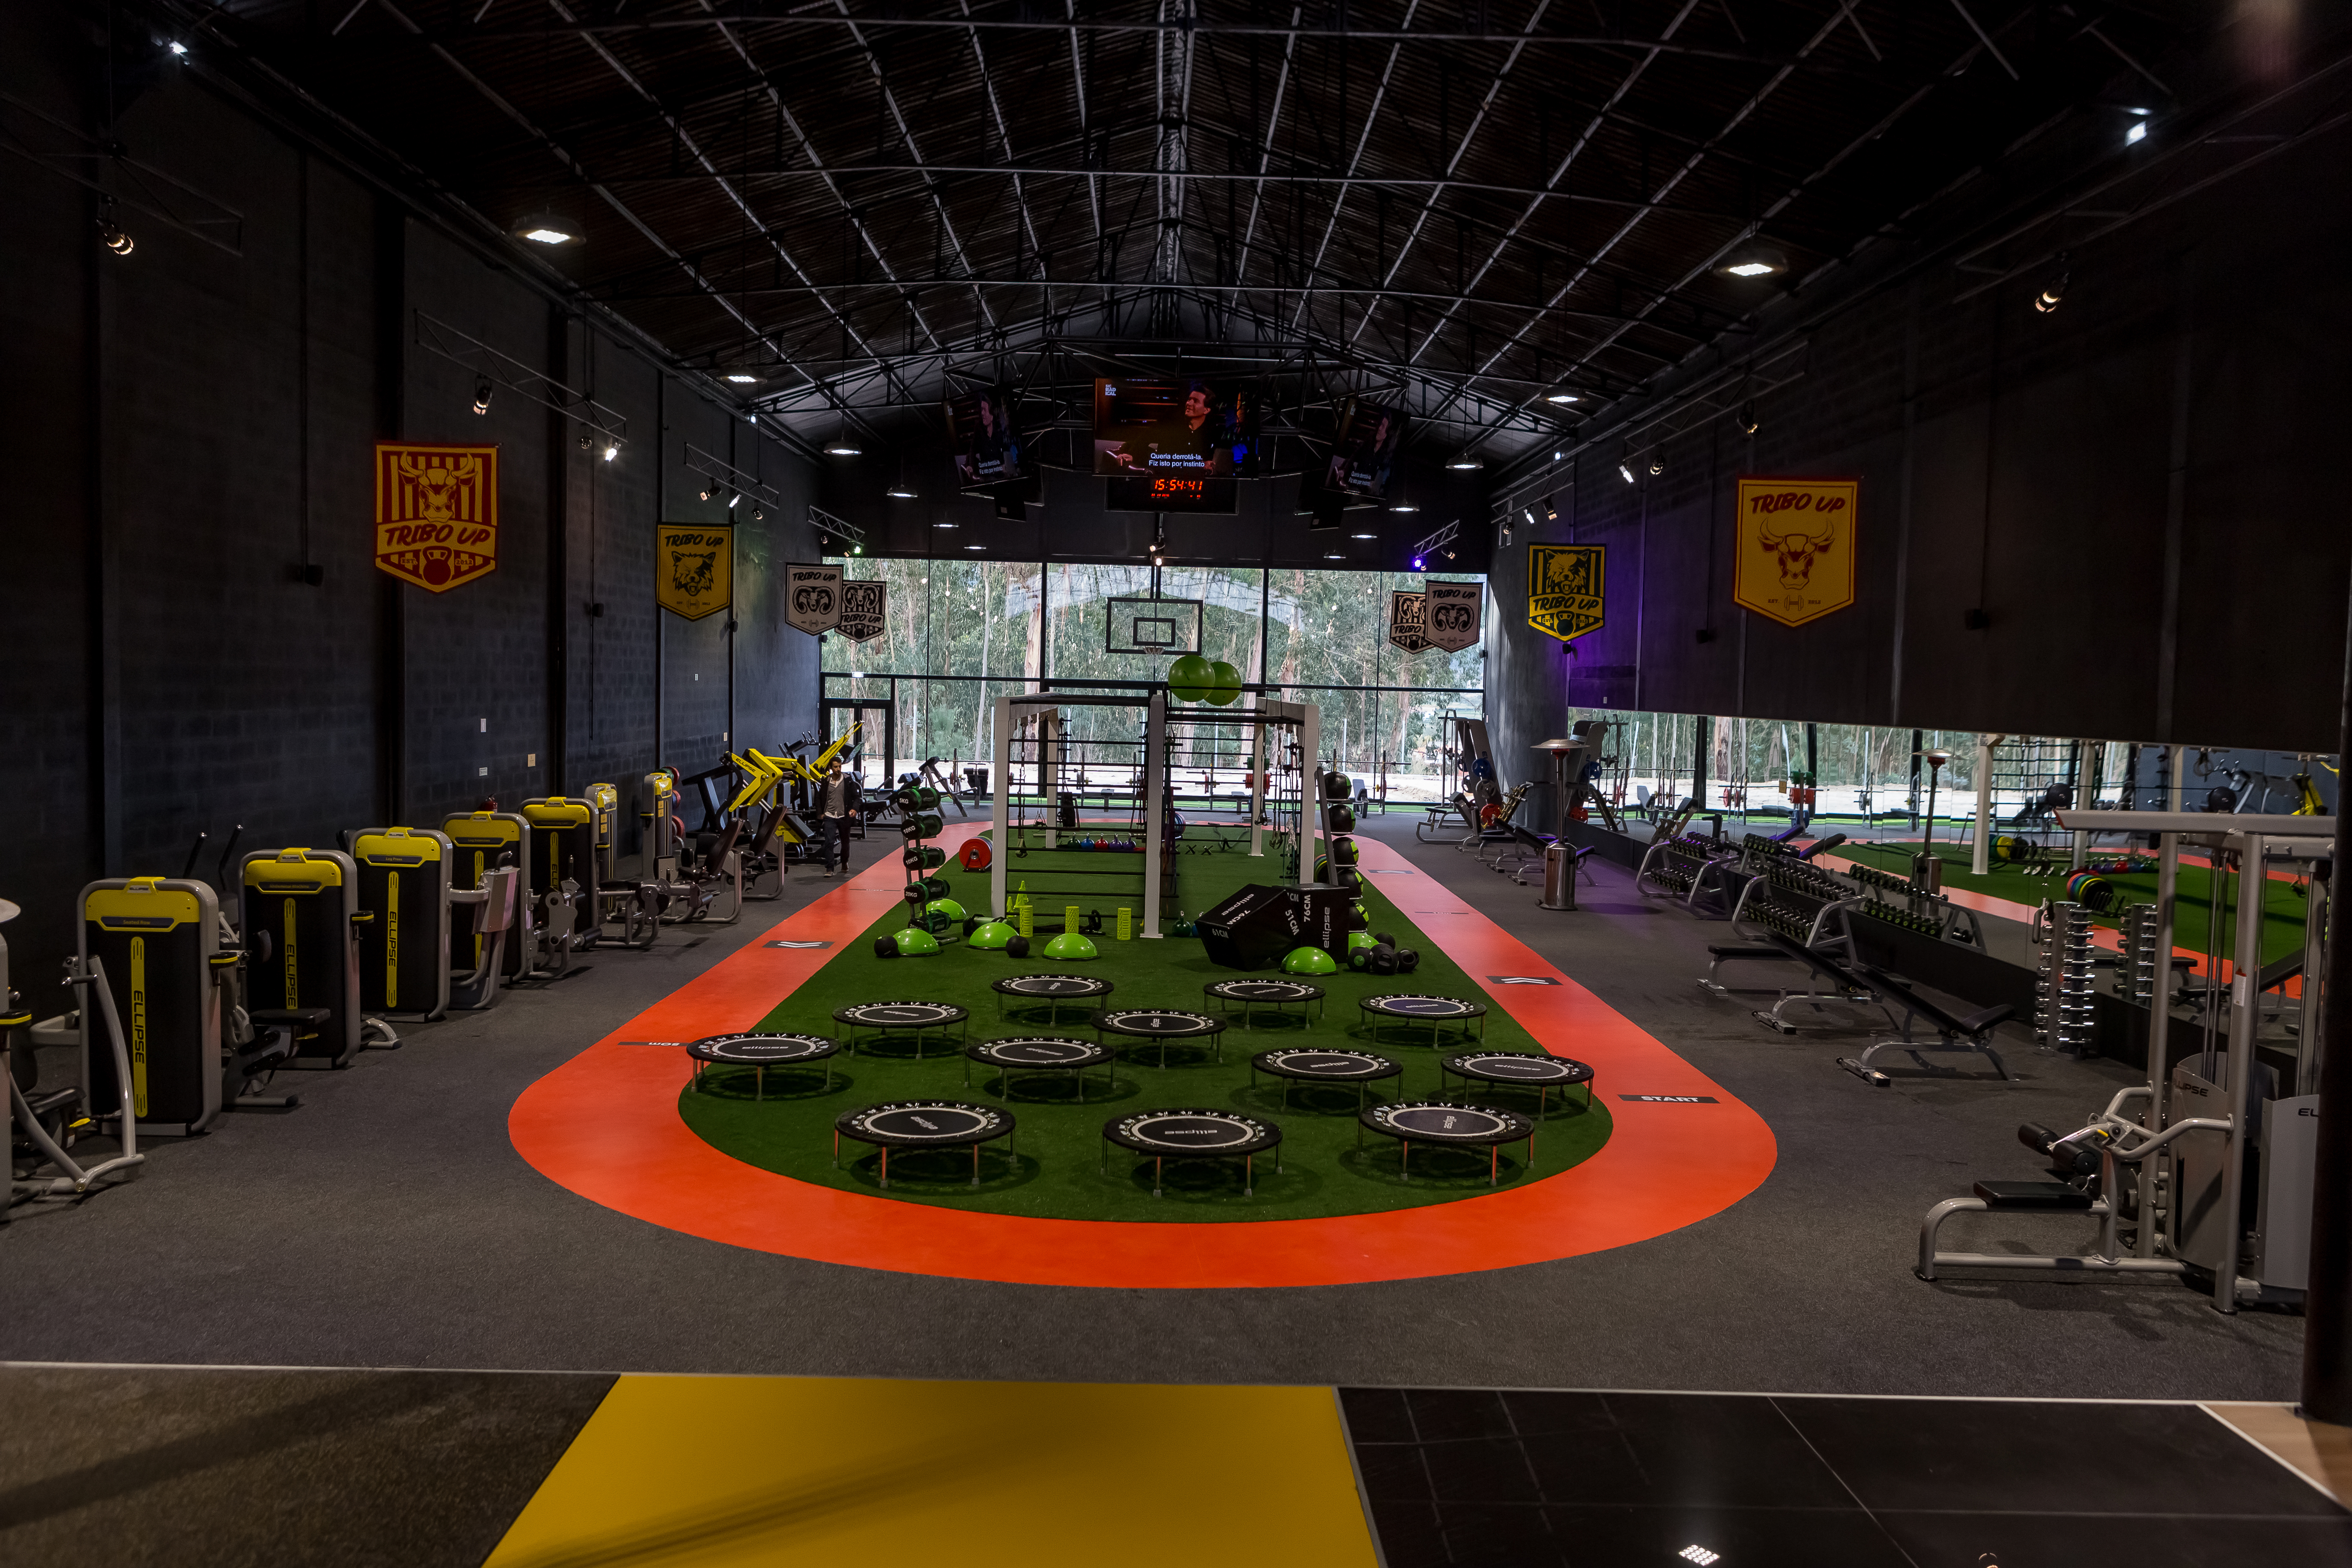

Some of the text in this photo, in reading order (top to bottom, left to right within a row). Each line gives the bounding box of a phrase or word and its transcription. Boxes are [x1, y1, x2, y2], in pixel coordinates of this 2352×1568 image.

[1155, 479, 1203, 490] 15:54:41
[1751, 493, 1845, 514] TRIBO UP
[385, 524, 491, 546] TRIBO UP
[665, 533, 724, 547] TRIBO UP
[793, 571, 837, 582] TRIBO UP
[1433, 589, 1476, 599] TRIBO UP
[1533, 596, 1599, 611] TRIBO UP
[842, 614, 882, 624] TRIBO UP
[1394, 625, 1422, 634] TRIBO
[735, 758, 756, 773] ELLIPSE
[903, 826, 916, 834] 10KG
[906, 856, 918, 865] 10KG
[1287, 892, 1299, 902] CM
[1221, 894, 1254, 916] ellipse
[1227, 910, 1251, 925] 76CM
[1285, 909, 1299, 935] 51CM
[1212, 928, 1229, 939] 61CM
[1322, 907, 1332, 948] ellipse
[287, 944, 296, 1007] ELLIPSE
[134, 990, 144, 1064] ELLIPSE
